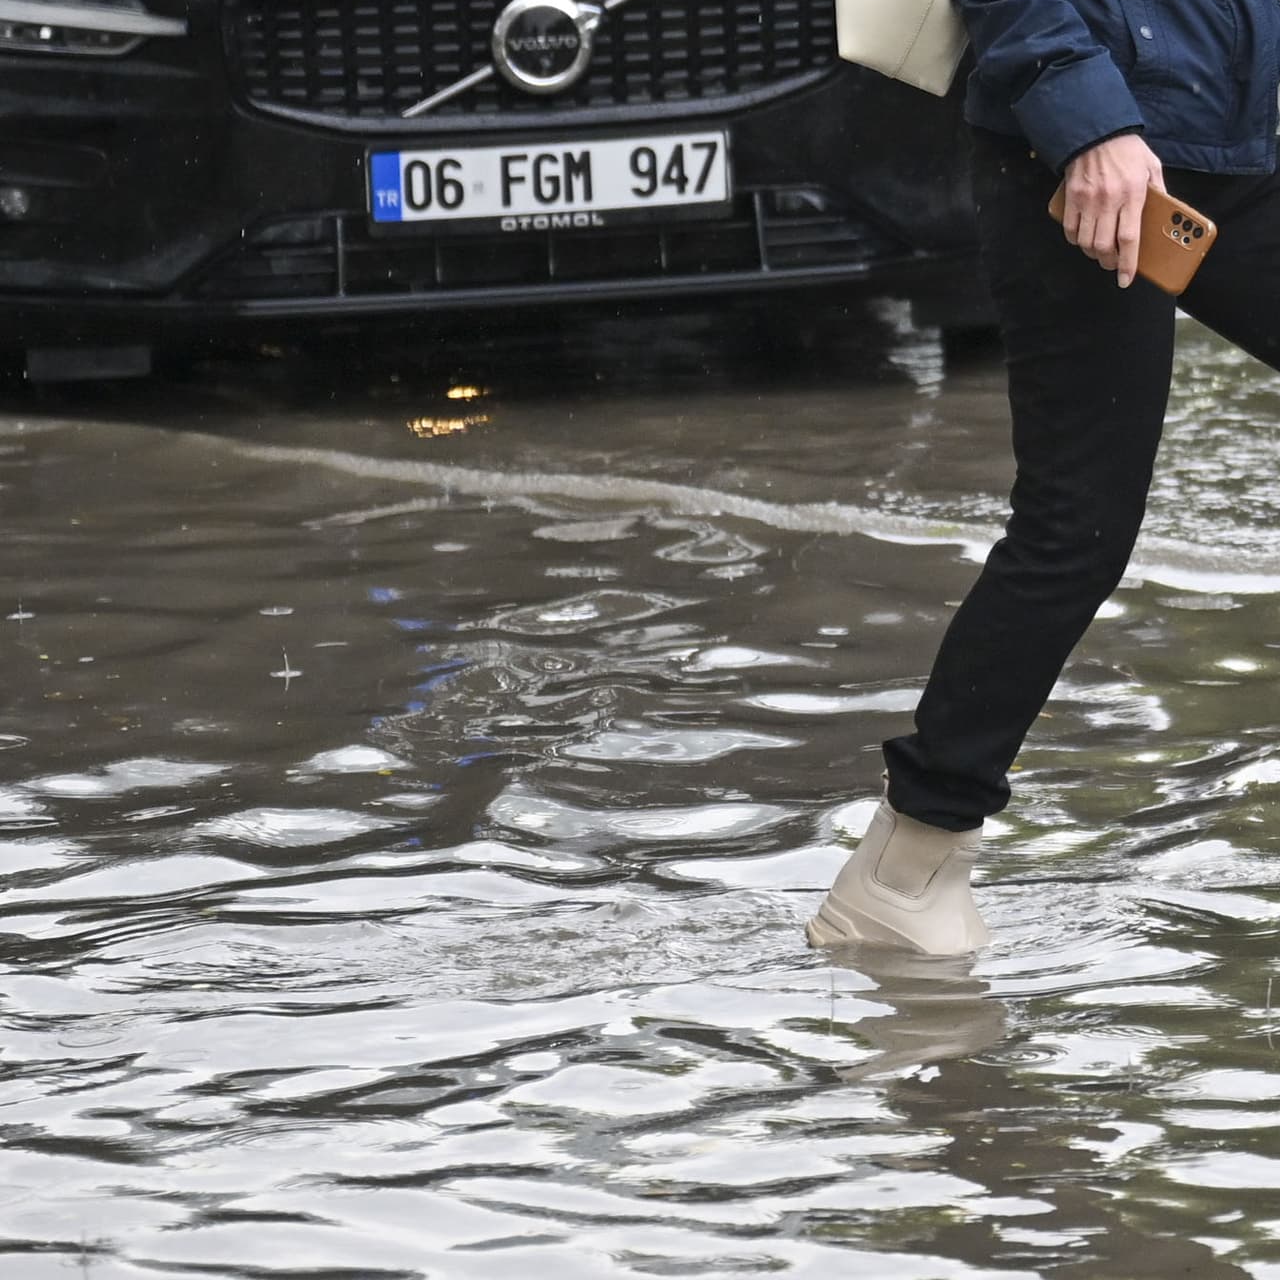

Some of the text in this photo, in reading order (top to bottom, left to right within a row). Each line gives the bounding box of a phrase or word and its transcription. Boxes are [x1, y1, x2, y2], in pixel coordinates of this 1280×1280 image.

[507, 34, 579, 51] VOLVO
[376, 141, 718, 211] TR 06 FGM 947
